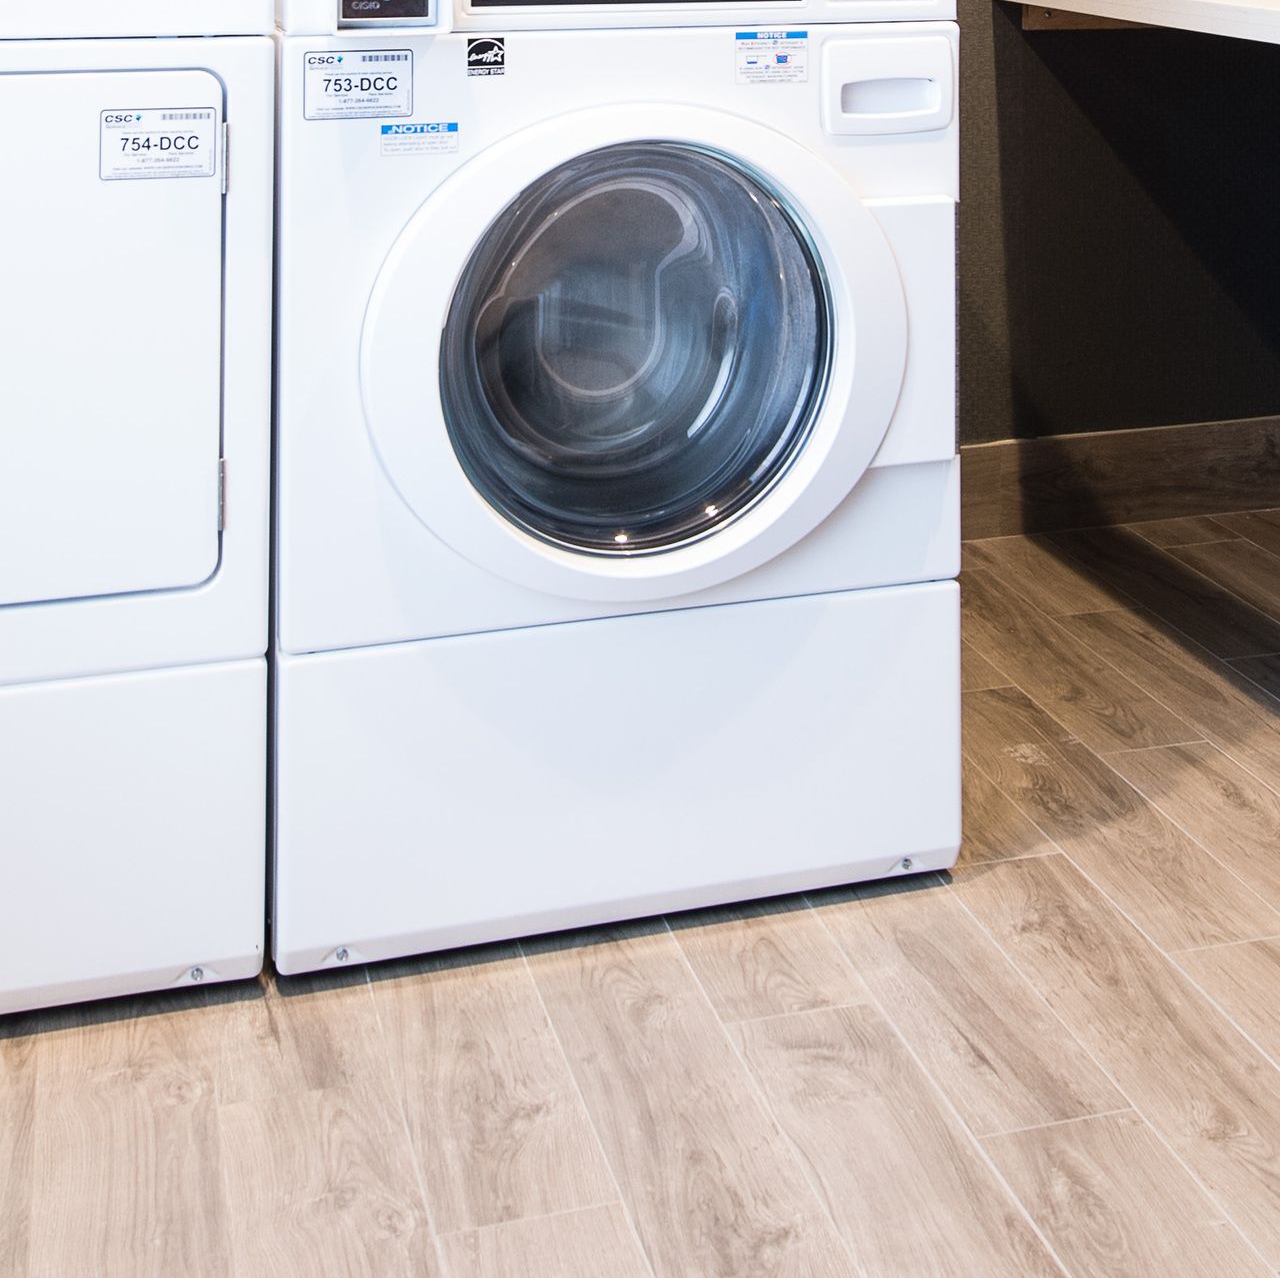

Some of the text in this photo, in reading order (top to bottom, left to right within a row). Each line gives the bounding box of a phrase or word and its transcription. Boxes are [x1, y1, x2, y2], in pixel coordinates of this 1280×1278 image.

[308, 56, 335, 65] CSC
[323, 77, 398, 92] 753-DCC
[105, 114, 133, 123] CSC
[392, 123, 448, 134] NOTICE
[120, 135, 199, 152] 754-DCC
